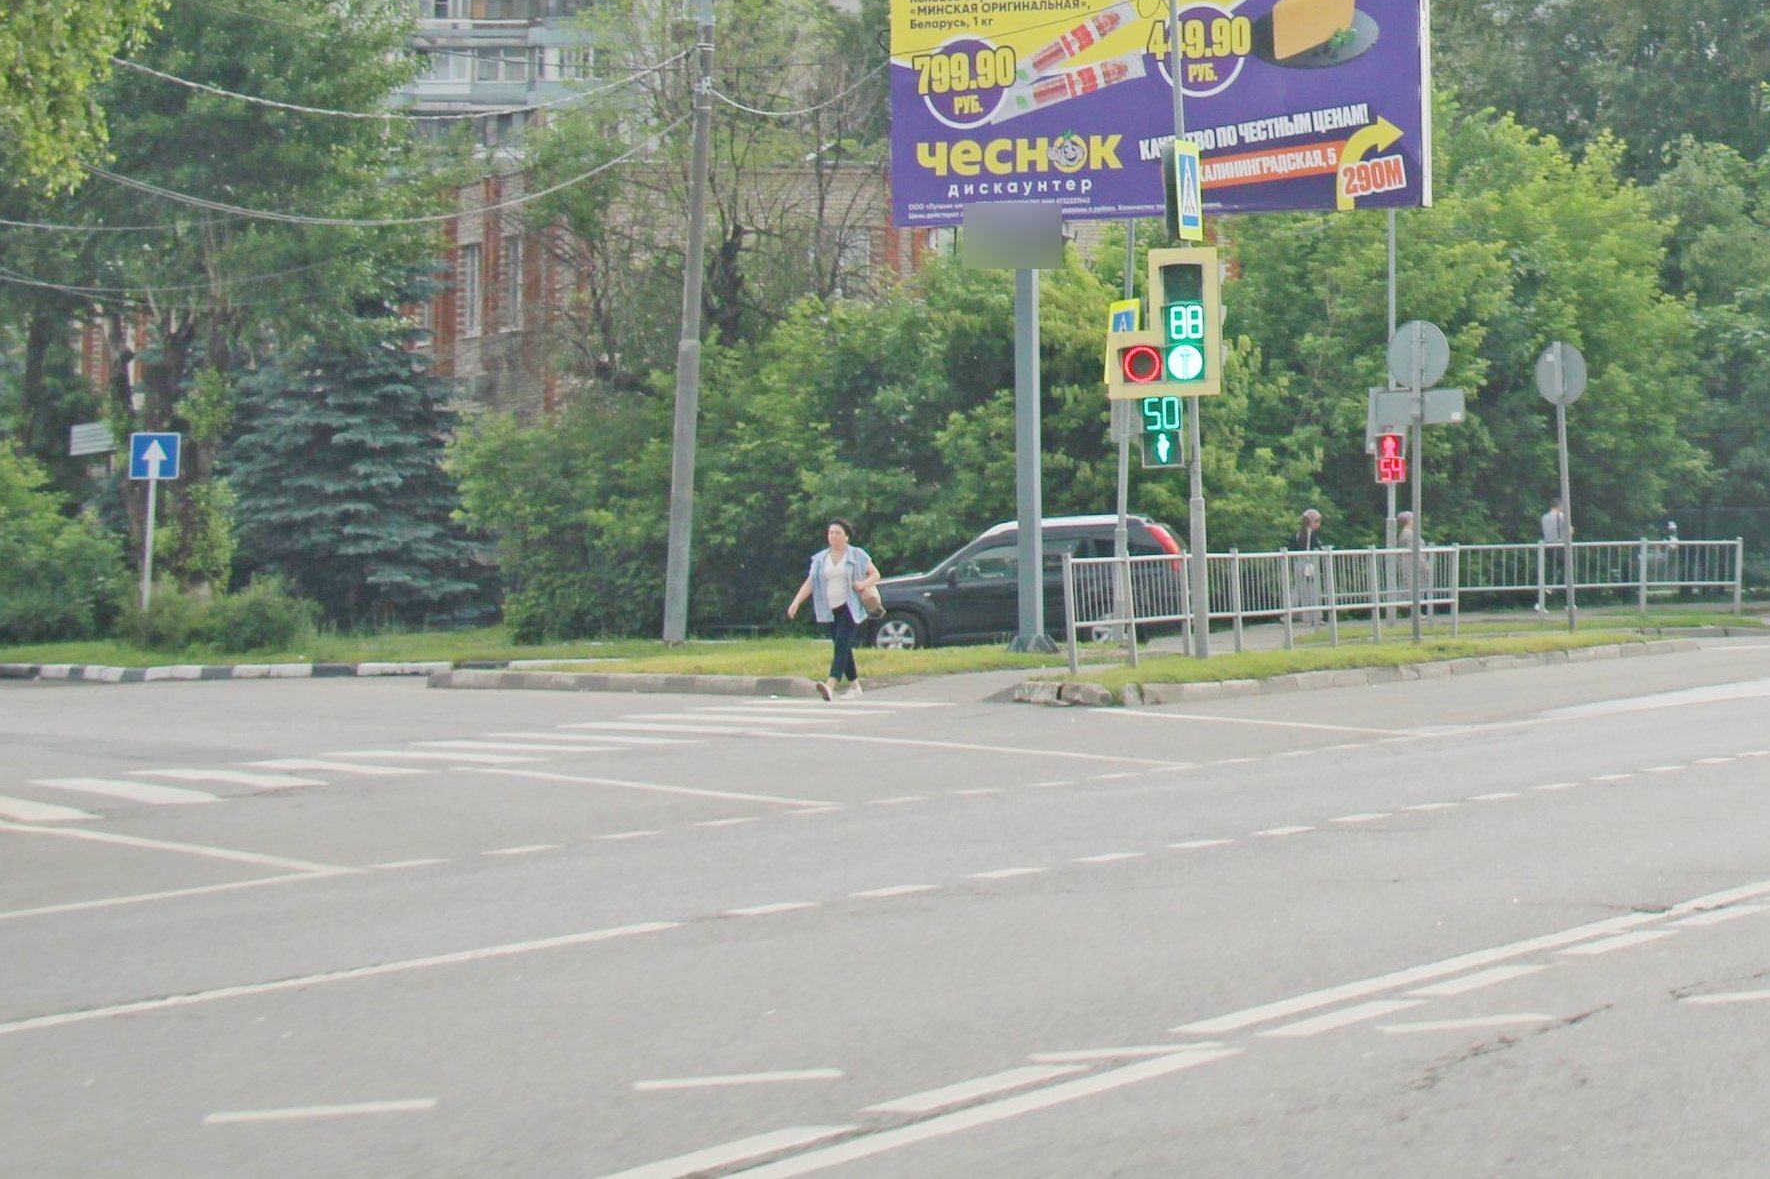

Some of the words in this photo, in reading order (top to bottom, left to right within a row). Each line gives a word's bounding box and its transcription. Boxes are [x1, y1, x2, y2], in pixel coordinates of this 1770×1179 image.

[910, 2, 979, 17] «МИНСКАЯ
[909, 18, 970, 30] Беларусь,
[973, 15, 979, 26] 1
[981, 17, 994, 27] кг
[912, 45, 1016, 96] 799.90
[1187, 63, 1219, 83] РУБ.
[953, 95, 984, 116] РУБ.
[1139, 129, 1216, 161] КАТВО
[1216, 127, 1239, 148] ПО
[1239, 112, 1312, 144] ЧЕСТНЫМ
[1312, 102, 1370, 134] ЦЕНАМ!
[1327, 148, 1337, 166] 5
[1343, 156, 1405, 196] 290М
[948, 179, 1093, 199] дискаунтер
[1169, 305, 1204, 340] 88
[1143, 396, 1180, 431] 50
[1380, 458, 1403, 481] 54
